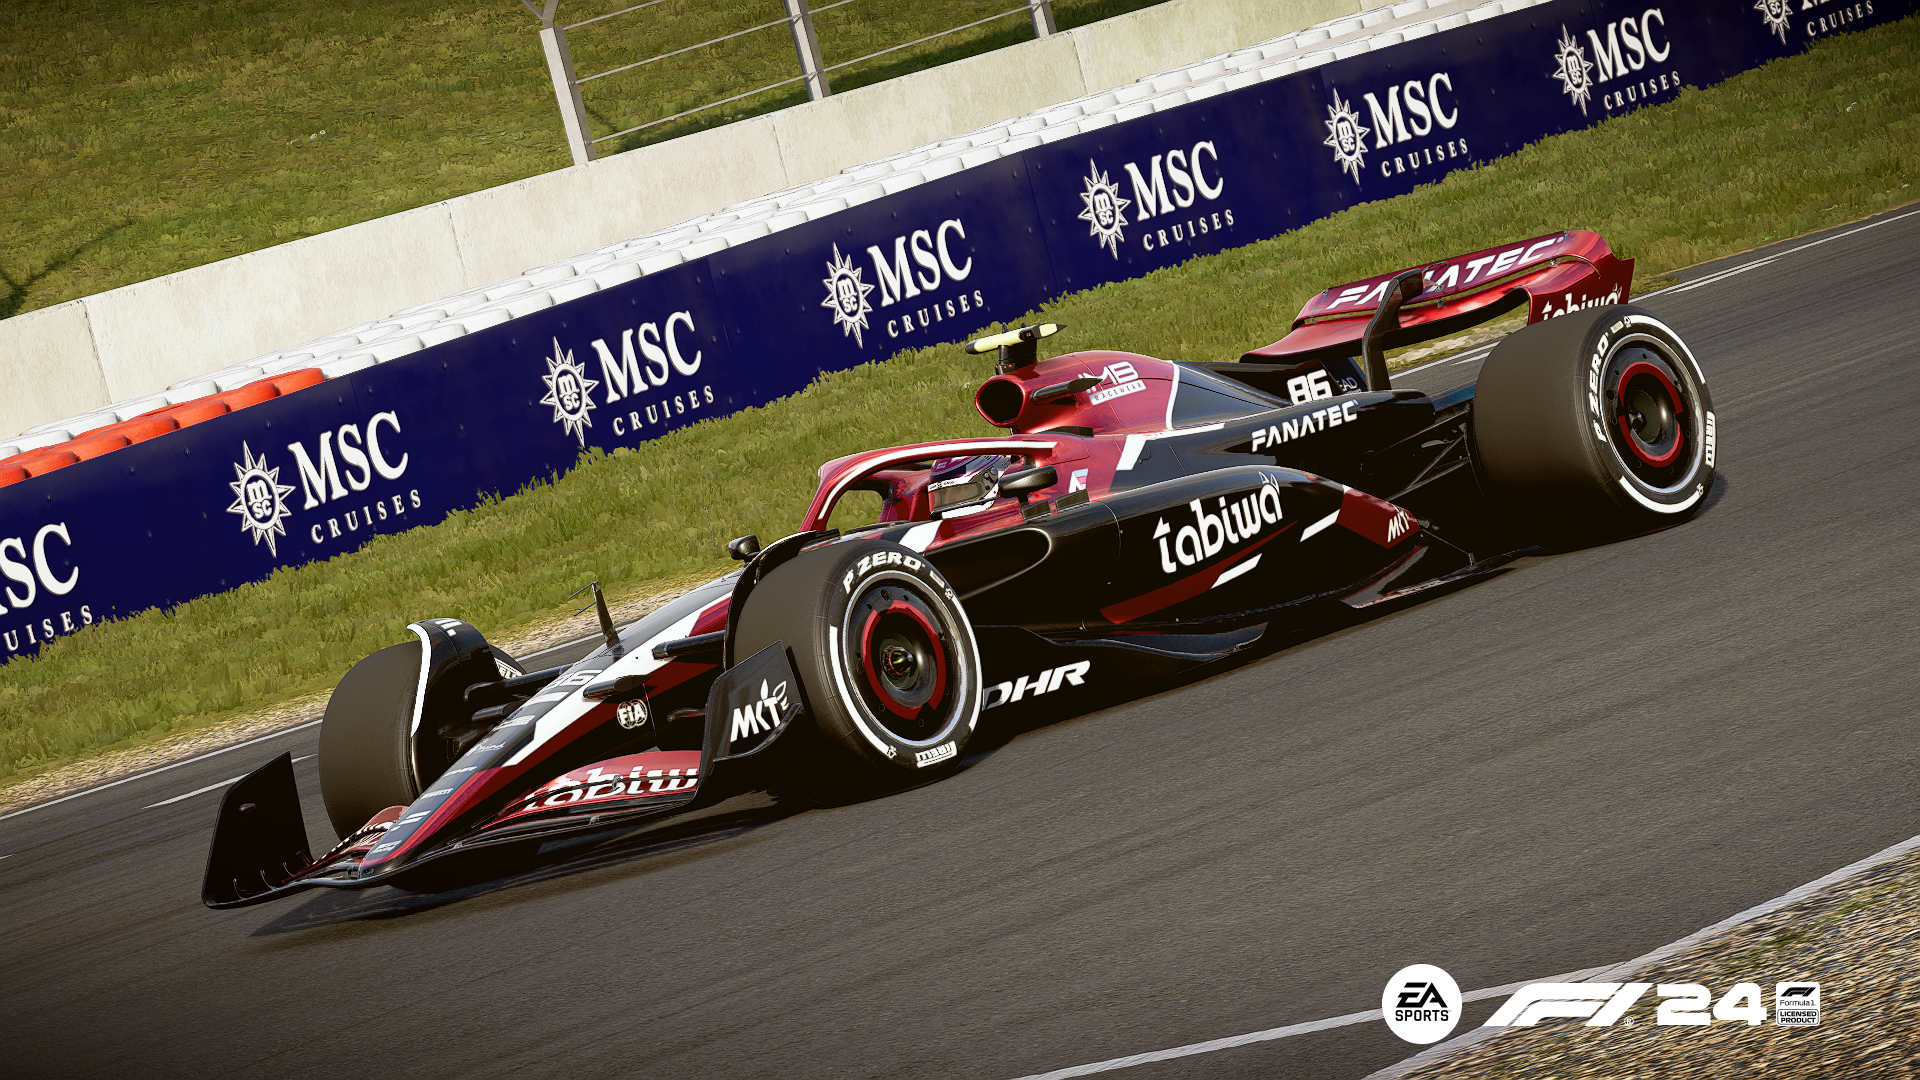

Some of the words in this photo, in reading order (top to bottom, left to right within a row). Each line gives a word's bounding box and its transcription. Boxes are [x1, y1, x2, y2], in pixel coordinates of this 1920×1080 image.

[1806, 0, 1873, 36] CRUISES
[1586, 8, 1671, 83] MSC
[1363, 72, 1458, 149] MSC
[1604, 70, 1681, 110] CRUISES
[1123, 140, 1224, 222] MSC
[1381, 137, 1468, 178] CRUISES
[1143, 209, 1234, 251] CRUISES
[866, 218, 973, 308] MSC
[887, 289, 984, 338] CRUISES
[590, 310, 702, 404] MSC
[1587, 333, 1609, 418] ZERO
[612, 385, 714, 436] CRUISES
[1093, 382, 1142, 402] RACEWEAR
[1287, 368, 1333, 406] 86
[1251, 399, 1358, 453] FANATEC
[287, 410, 409, 510] MSC
[311, 489, 422, 545] CRUISES
[1152, 480, 1284, 574] tabiwa
[0, 521, 80, 616] SC
[842, 569, 854, 595] P
[857, 551, 923, 577] ZERO
[2, 605, 93, 652] UISES
[981, 660, 1091, 711] DHR
[523, 765, 698, 811] tabiw
